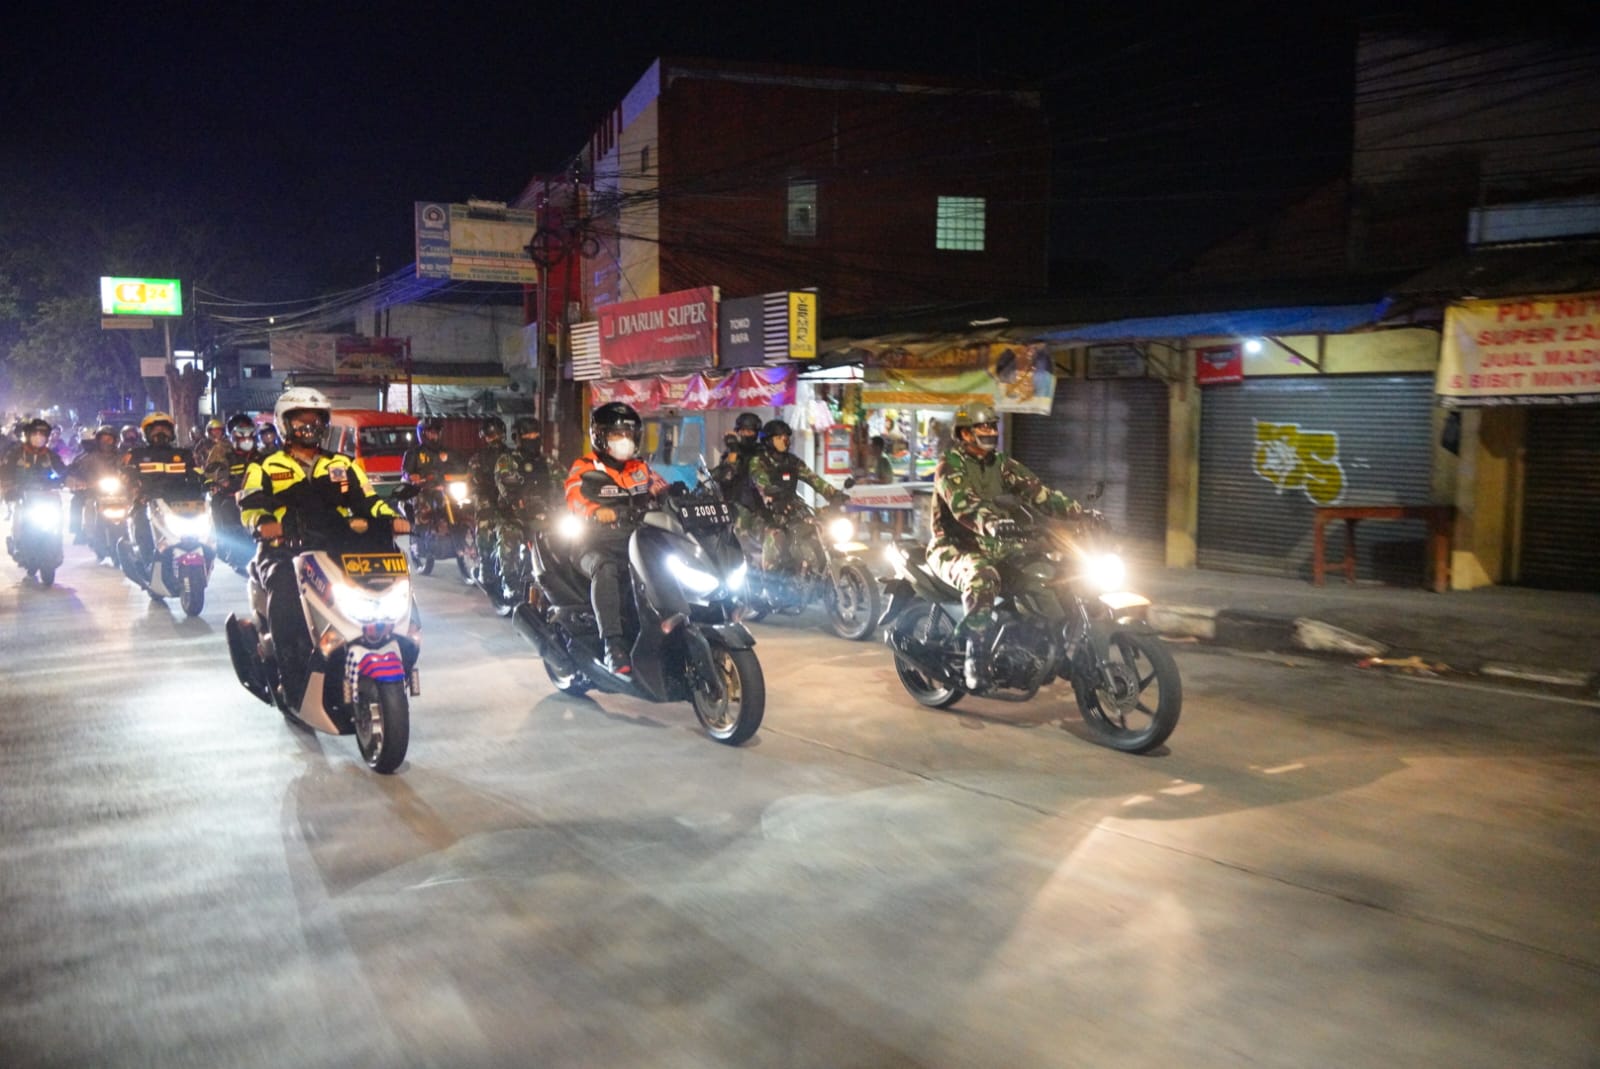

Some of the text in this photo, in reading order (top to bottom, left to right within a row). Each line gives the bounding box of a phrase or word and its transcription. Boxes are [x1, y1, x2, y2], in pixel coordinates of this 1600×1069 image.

[618, 302, 707, 337] DJARUM SUPER
[729, 317, 750, 330] TOKO
[1478, 329, 1555, 346] SUPER
